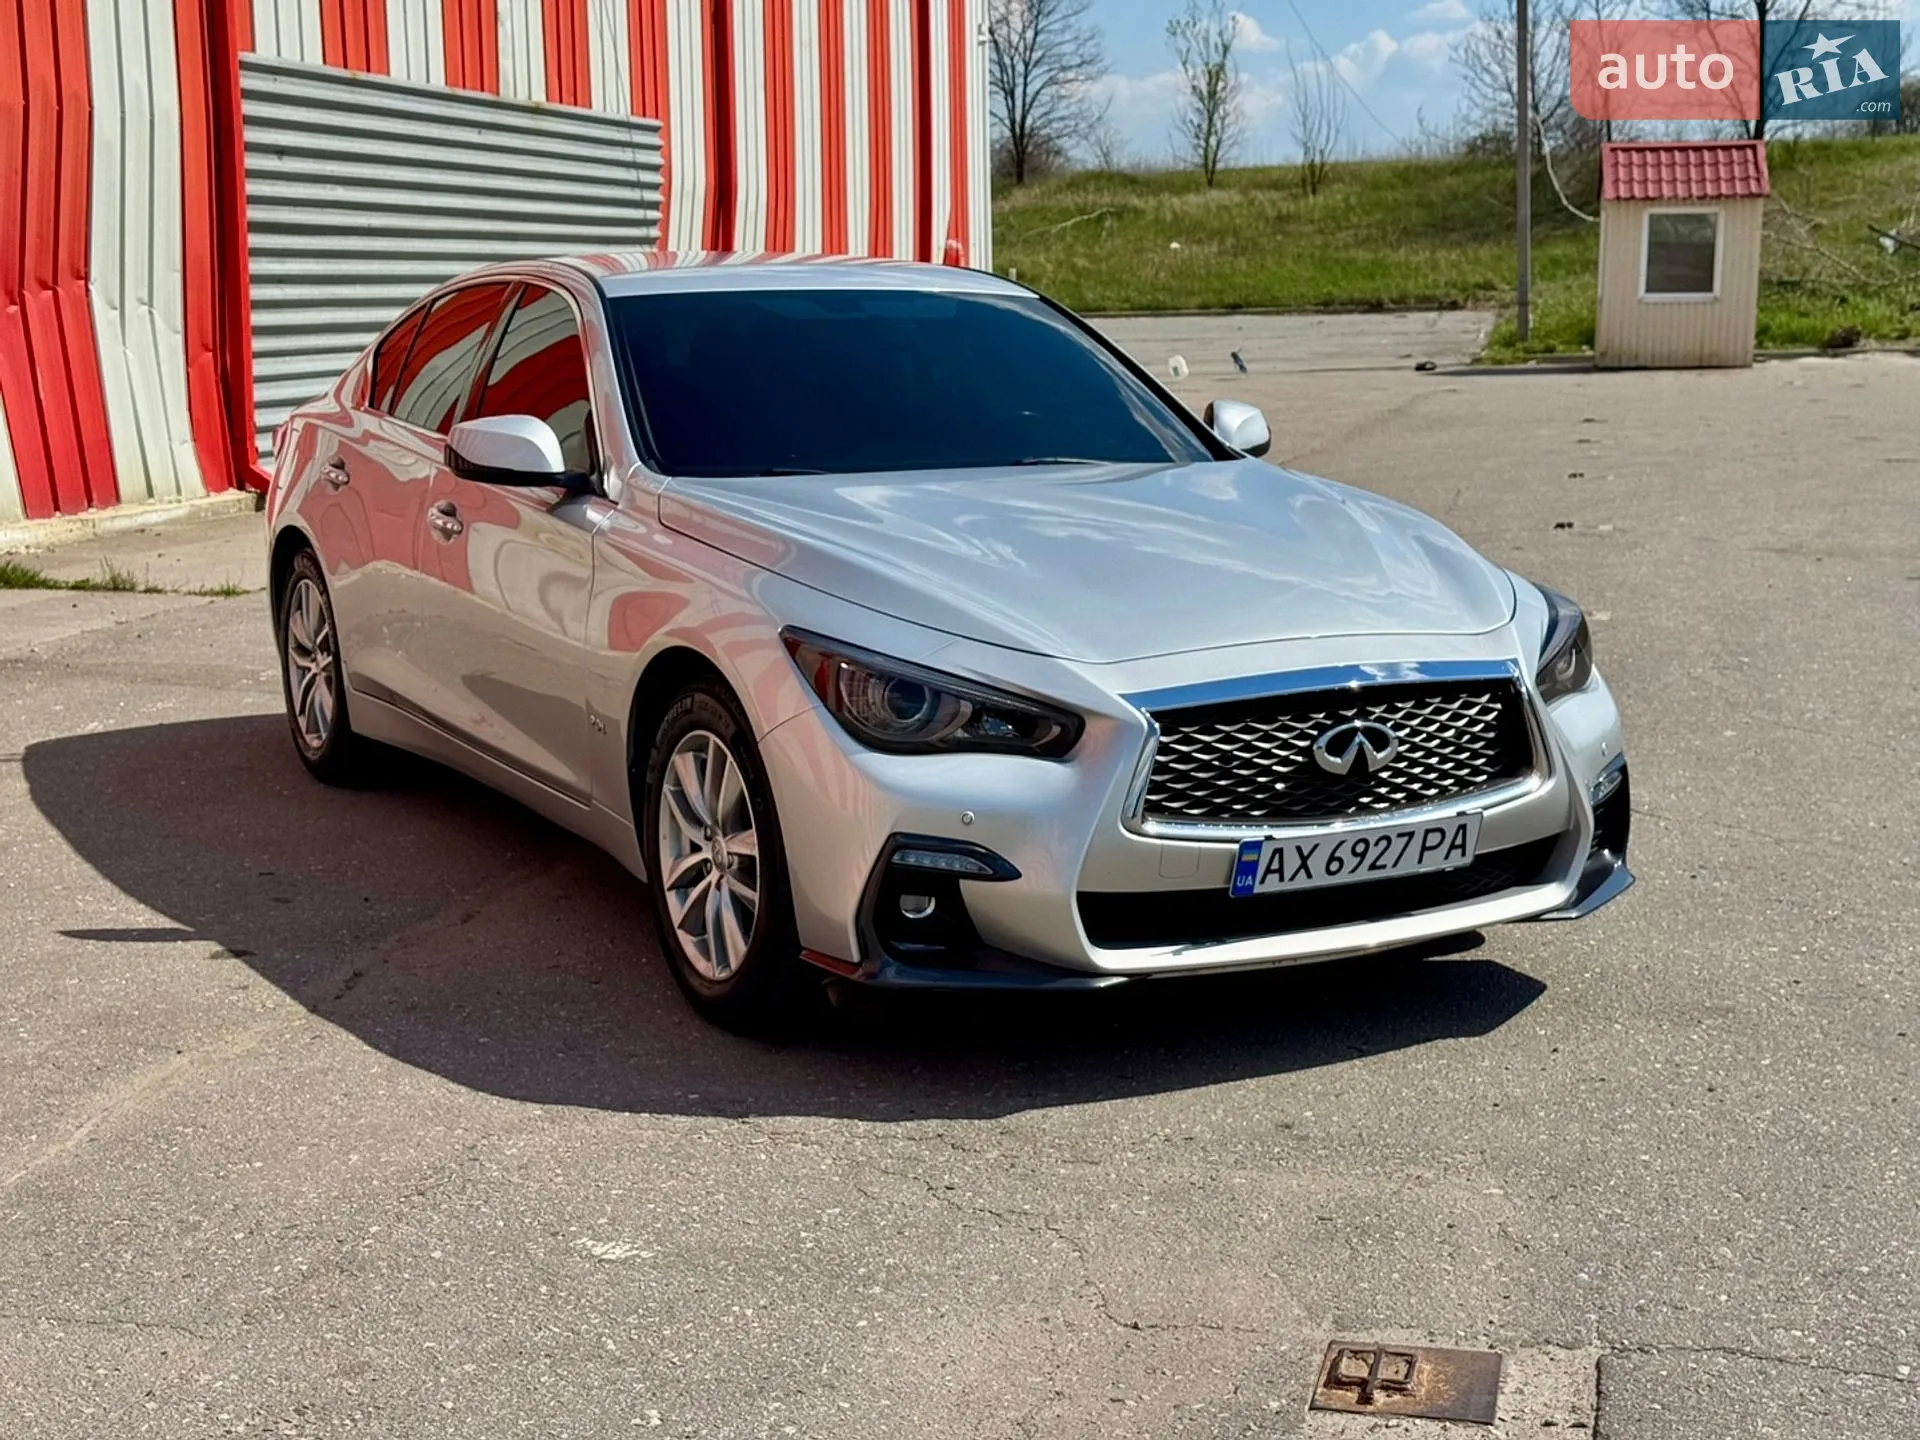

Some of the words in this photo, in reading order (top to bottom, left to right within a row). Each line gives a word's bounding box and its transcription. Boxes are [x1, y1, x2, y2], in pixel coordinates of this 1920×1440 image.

[1259, 843, 1321, 885] AX
[1325, 831, 1416, 876] 6927
[1417, 823, 1468, 864] PA
[1236, 875, 1254, 888] UA
